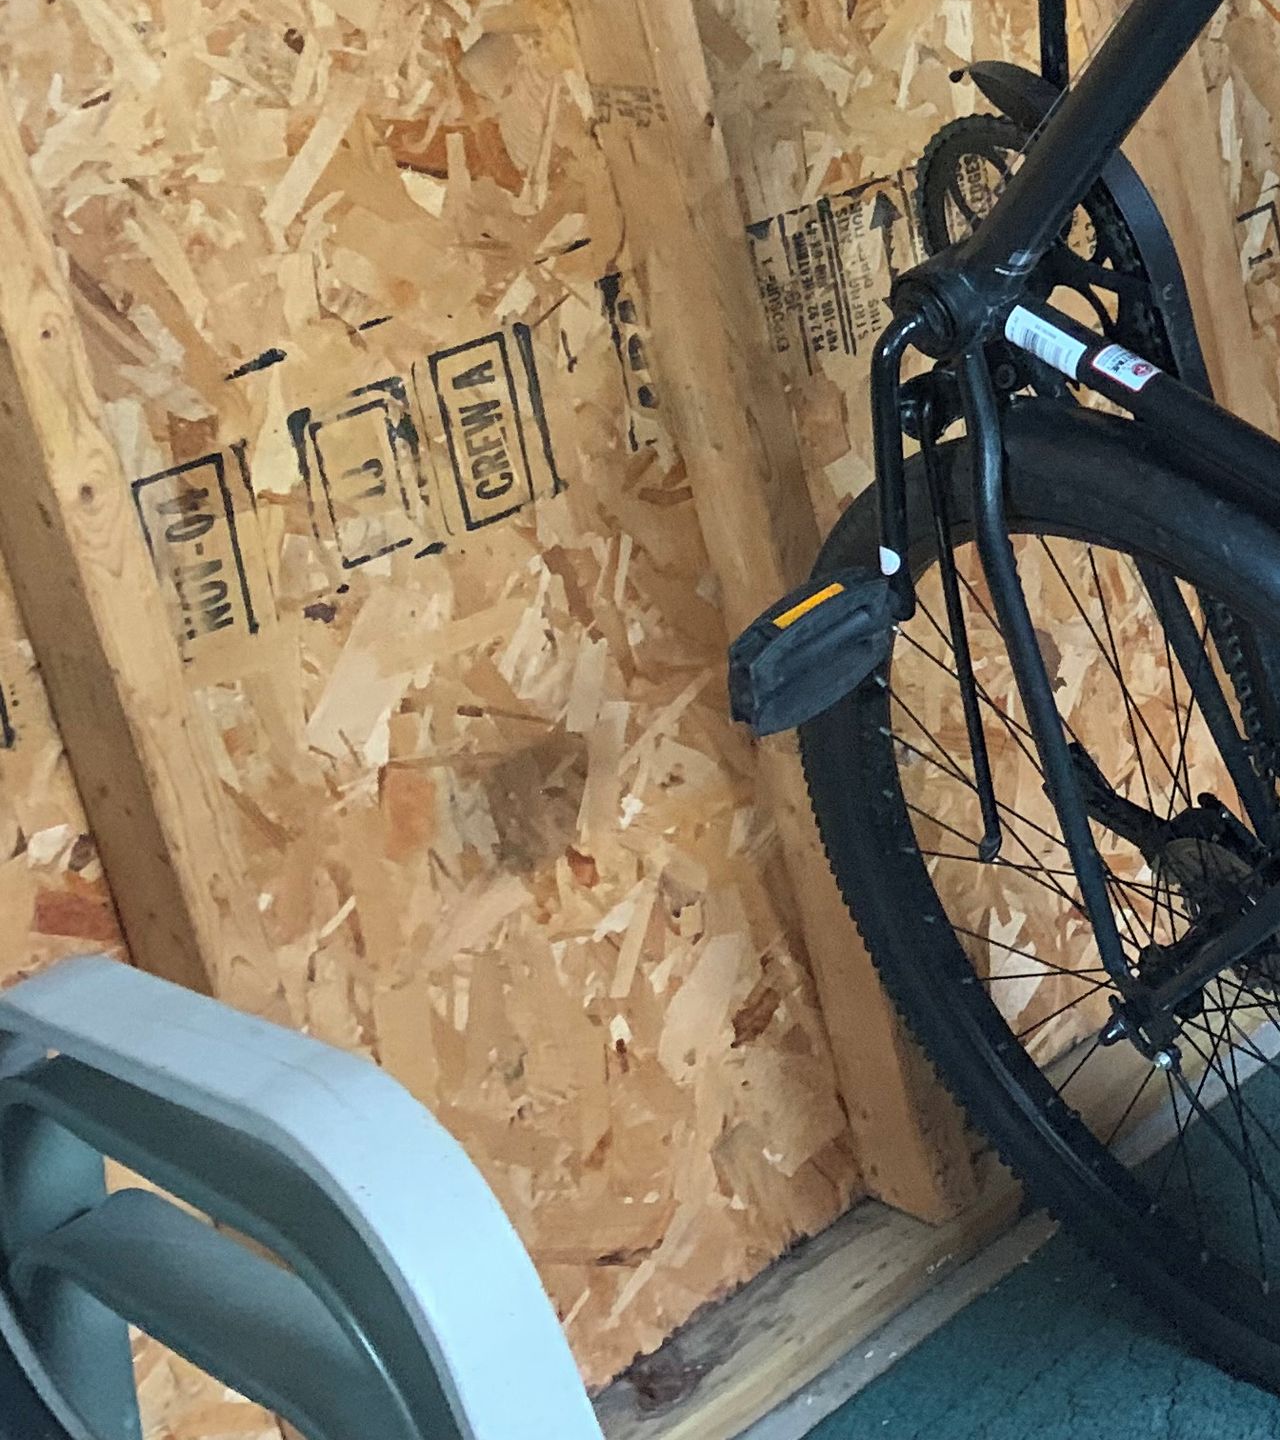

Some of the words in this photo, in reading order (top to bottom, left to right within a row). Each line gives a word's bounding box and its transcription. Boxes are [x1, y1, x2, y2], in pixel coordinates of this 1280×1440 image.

[452, 359, 496, 390] A
[459, 398, 514, 501] CREW
[156, 487, 234, 641] NOV-04
